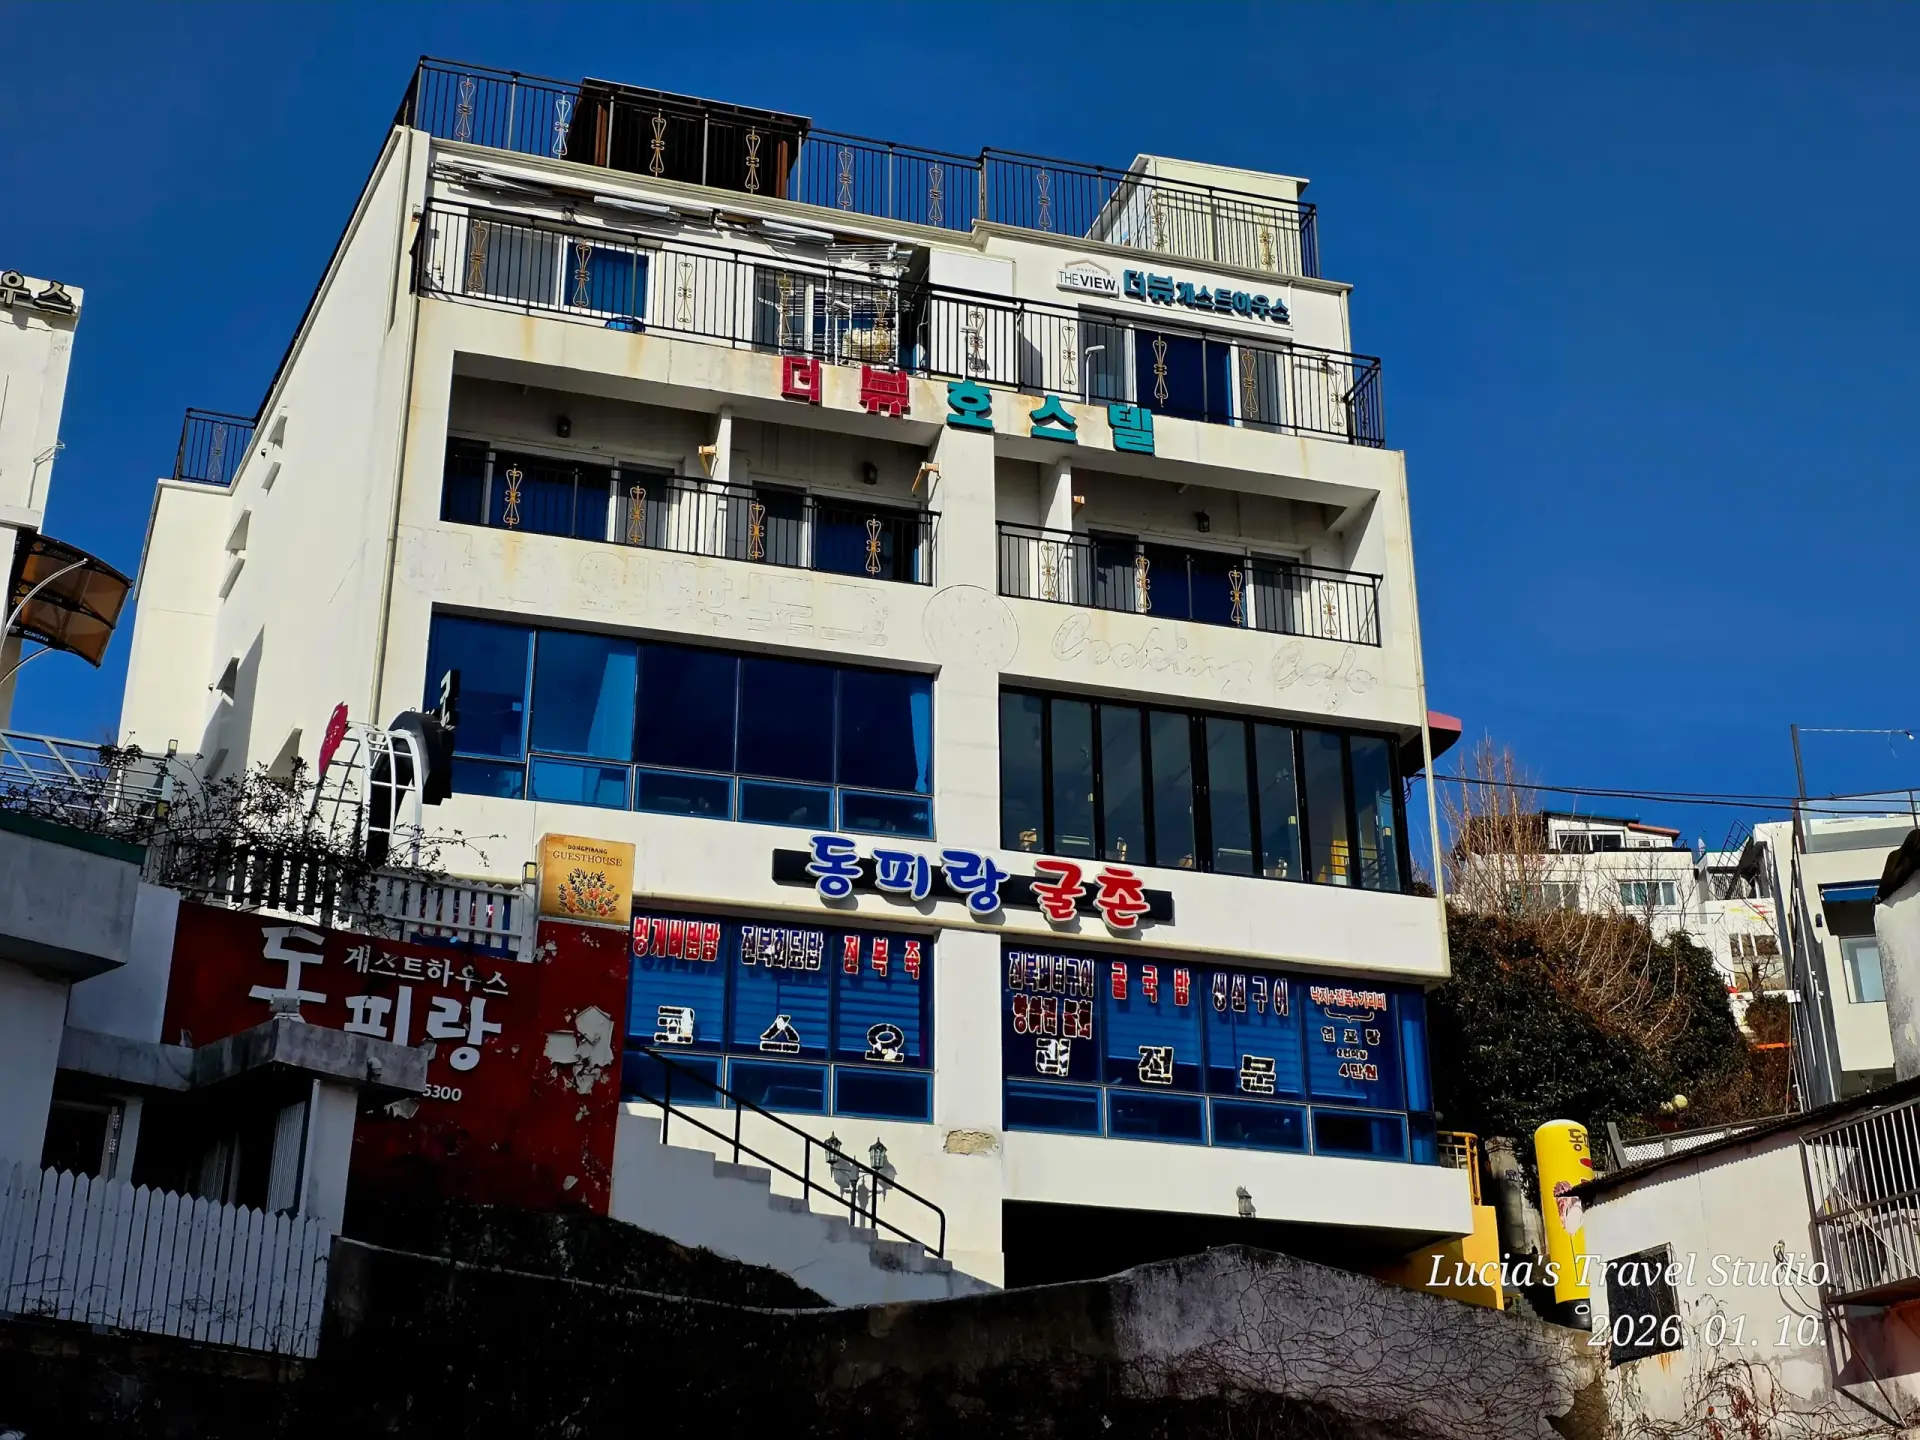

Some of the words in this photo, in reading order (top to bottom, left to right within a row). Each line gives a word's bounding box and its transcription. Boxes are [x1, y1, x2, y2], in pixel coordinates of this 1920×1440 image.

[1059, 271, 1078, 286] THE
[1080, 274, 1116, 291] VIEW
[552, 850, 623, 867] GUESTHOUSE
[567, 844, 608, 855] DONGPIRANG
[806, 833, 1011, 916] 동피랑
[1031, 858, 1152, 931] 굴촌
[343, 944, 509, 996] 게스트하우스
